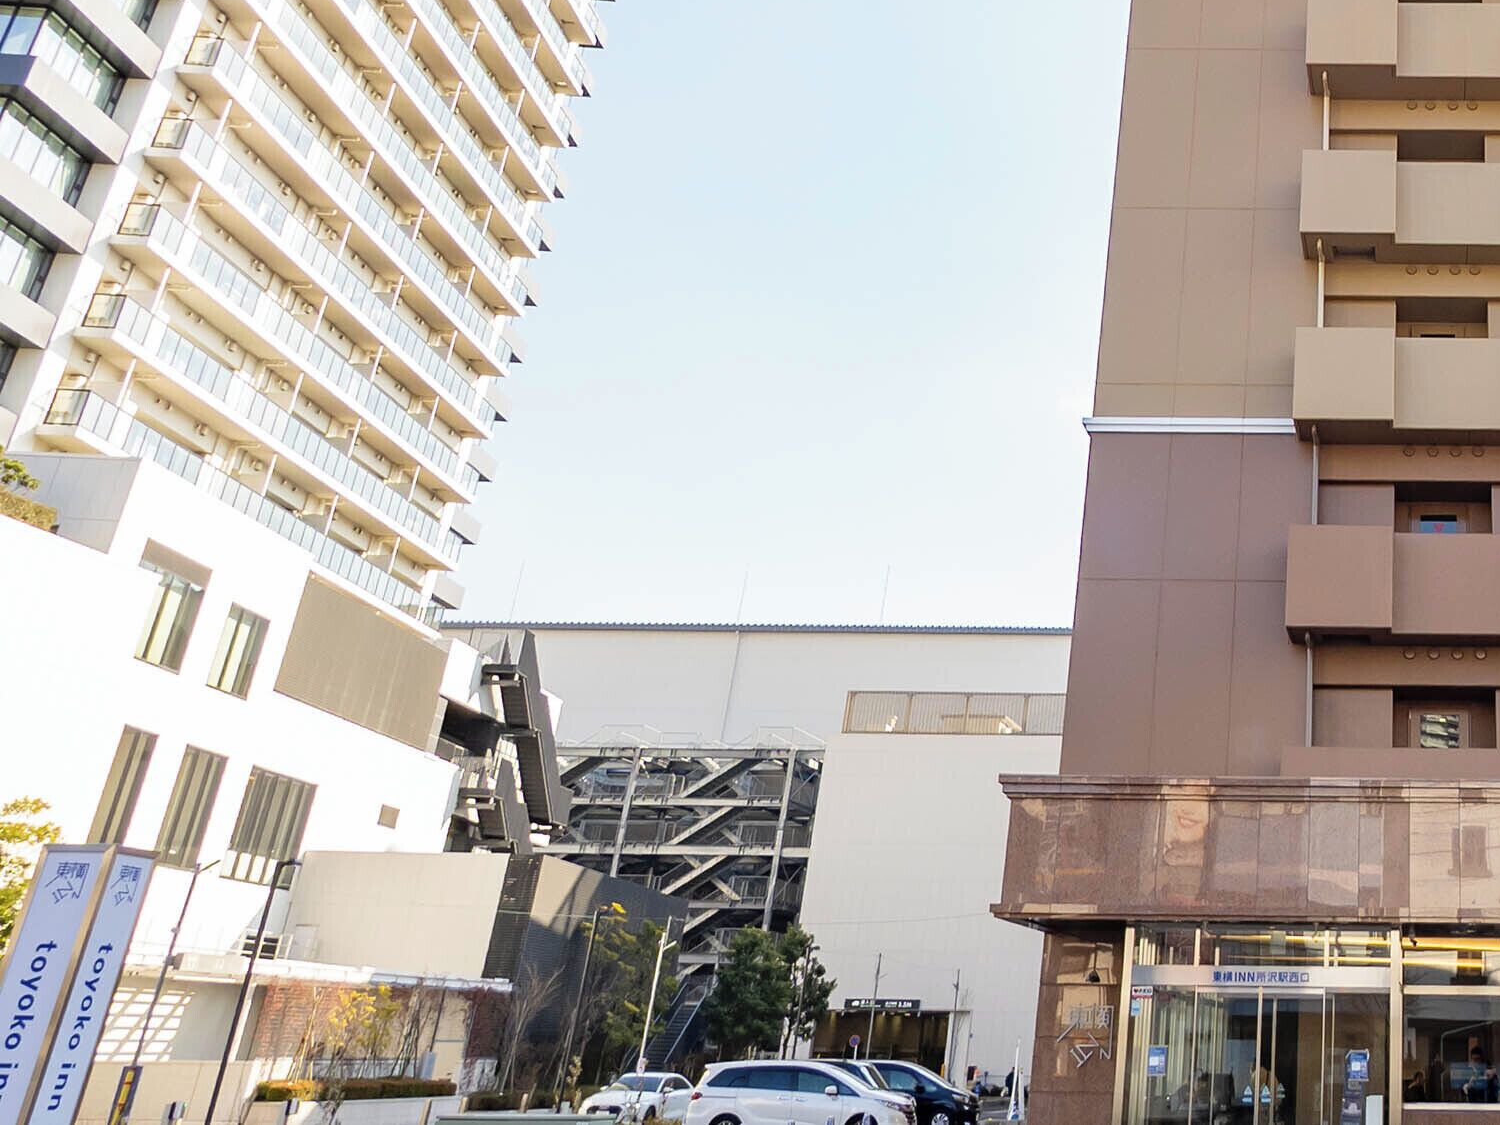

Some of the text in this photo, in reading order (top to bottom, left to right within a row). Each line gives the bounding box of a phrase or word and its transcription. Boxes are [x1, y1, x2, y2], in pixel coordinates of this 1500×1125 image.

[5, 940, 58, 1050] toyoko
[47, 943, 113, 1111] toyoko inn
[1213, 971, 1310, 983] 東横INN所沢駅西口
